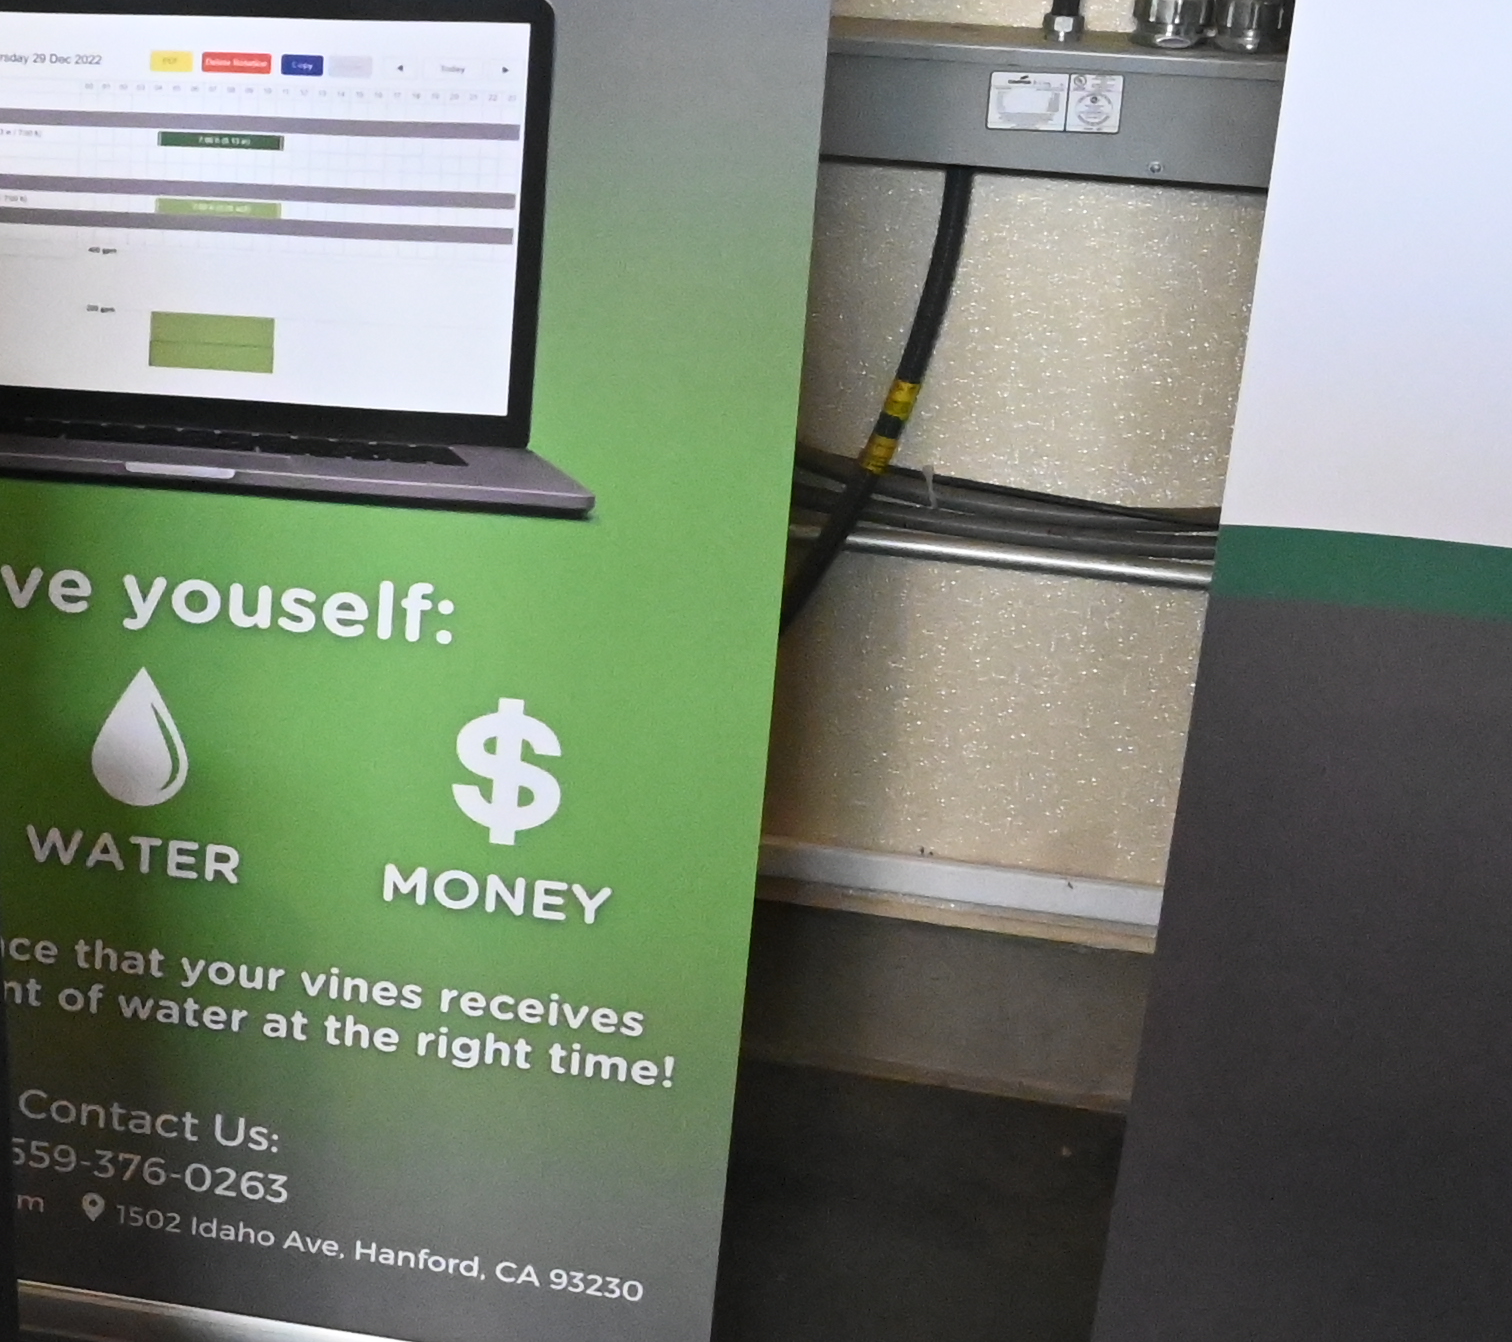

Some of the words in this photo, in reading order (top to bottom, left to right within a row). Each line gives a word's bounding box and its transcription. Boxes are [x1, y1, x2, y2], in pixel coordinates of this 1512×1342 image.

[32, 52, 46, 64] 29
[49, 53, 71, 65] Dec
[74, 54, 103, 66] 2022
[122, 573, 455, 646] youself:
[27, 824, 240, 885] WATER
[383, 863, 613, 926] MONEY
[58, 981, 104, 1016] of
[117, 994, 249, 1033] water
[262, 1008, 307, 1043] at
[325, 1012, 400, 1054] the
[415, 1024, 532, 1071] right
[548, 1043, 676, 1090] time!
[75, 938, 166, 979] that
[180, 956, 285, 994] your
[300, 966, 423, 1011] vines
[439, 984, 644, 1038] receives
[17, 1088, 200, 1143] Contact
[212, 1113, 280, 1154] Us:
[115, 1202, 182, 1236] 1502
[189, 1214, 276, 1249] Idaho
[282, 1230, 345, 1262] Ave,
[353, 1239, 487, 1284] Hanford,
[495, 1259, 538, 1289] CA
[548, 1268, 643, 1304] 93230
